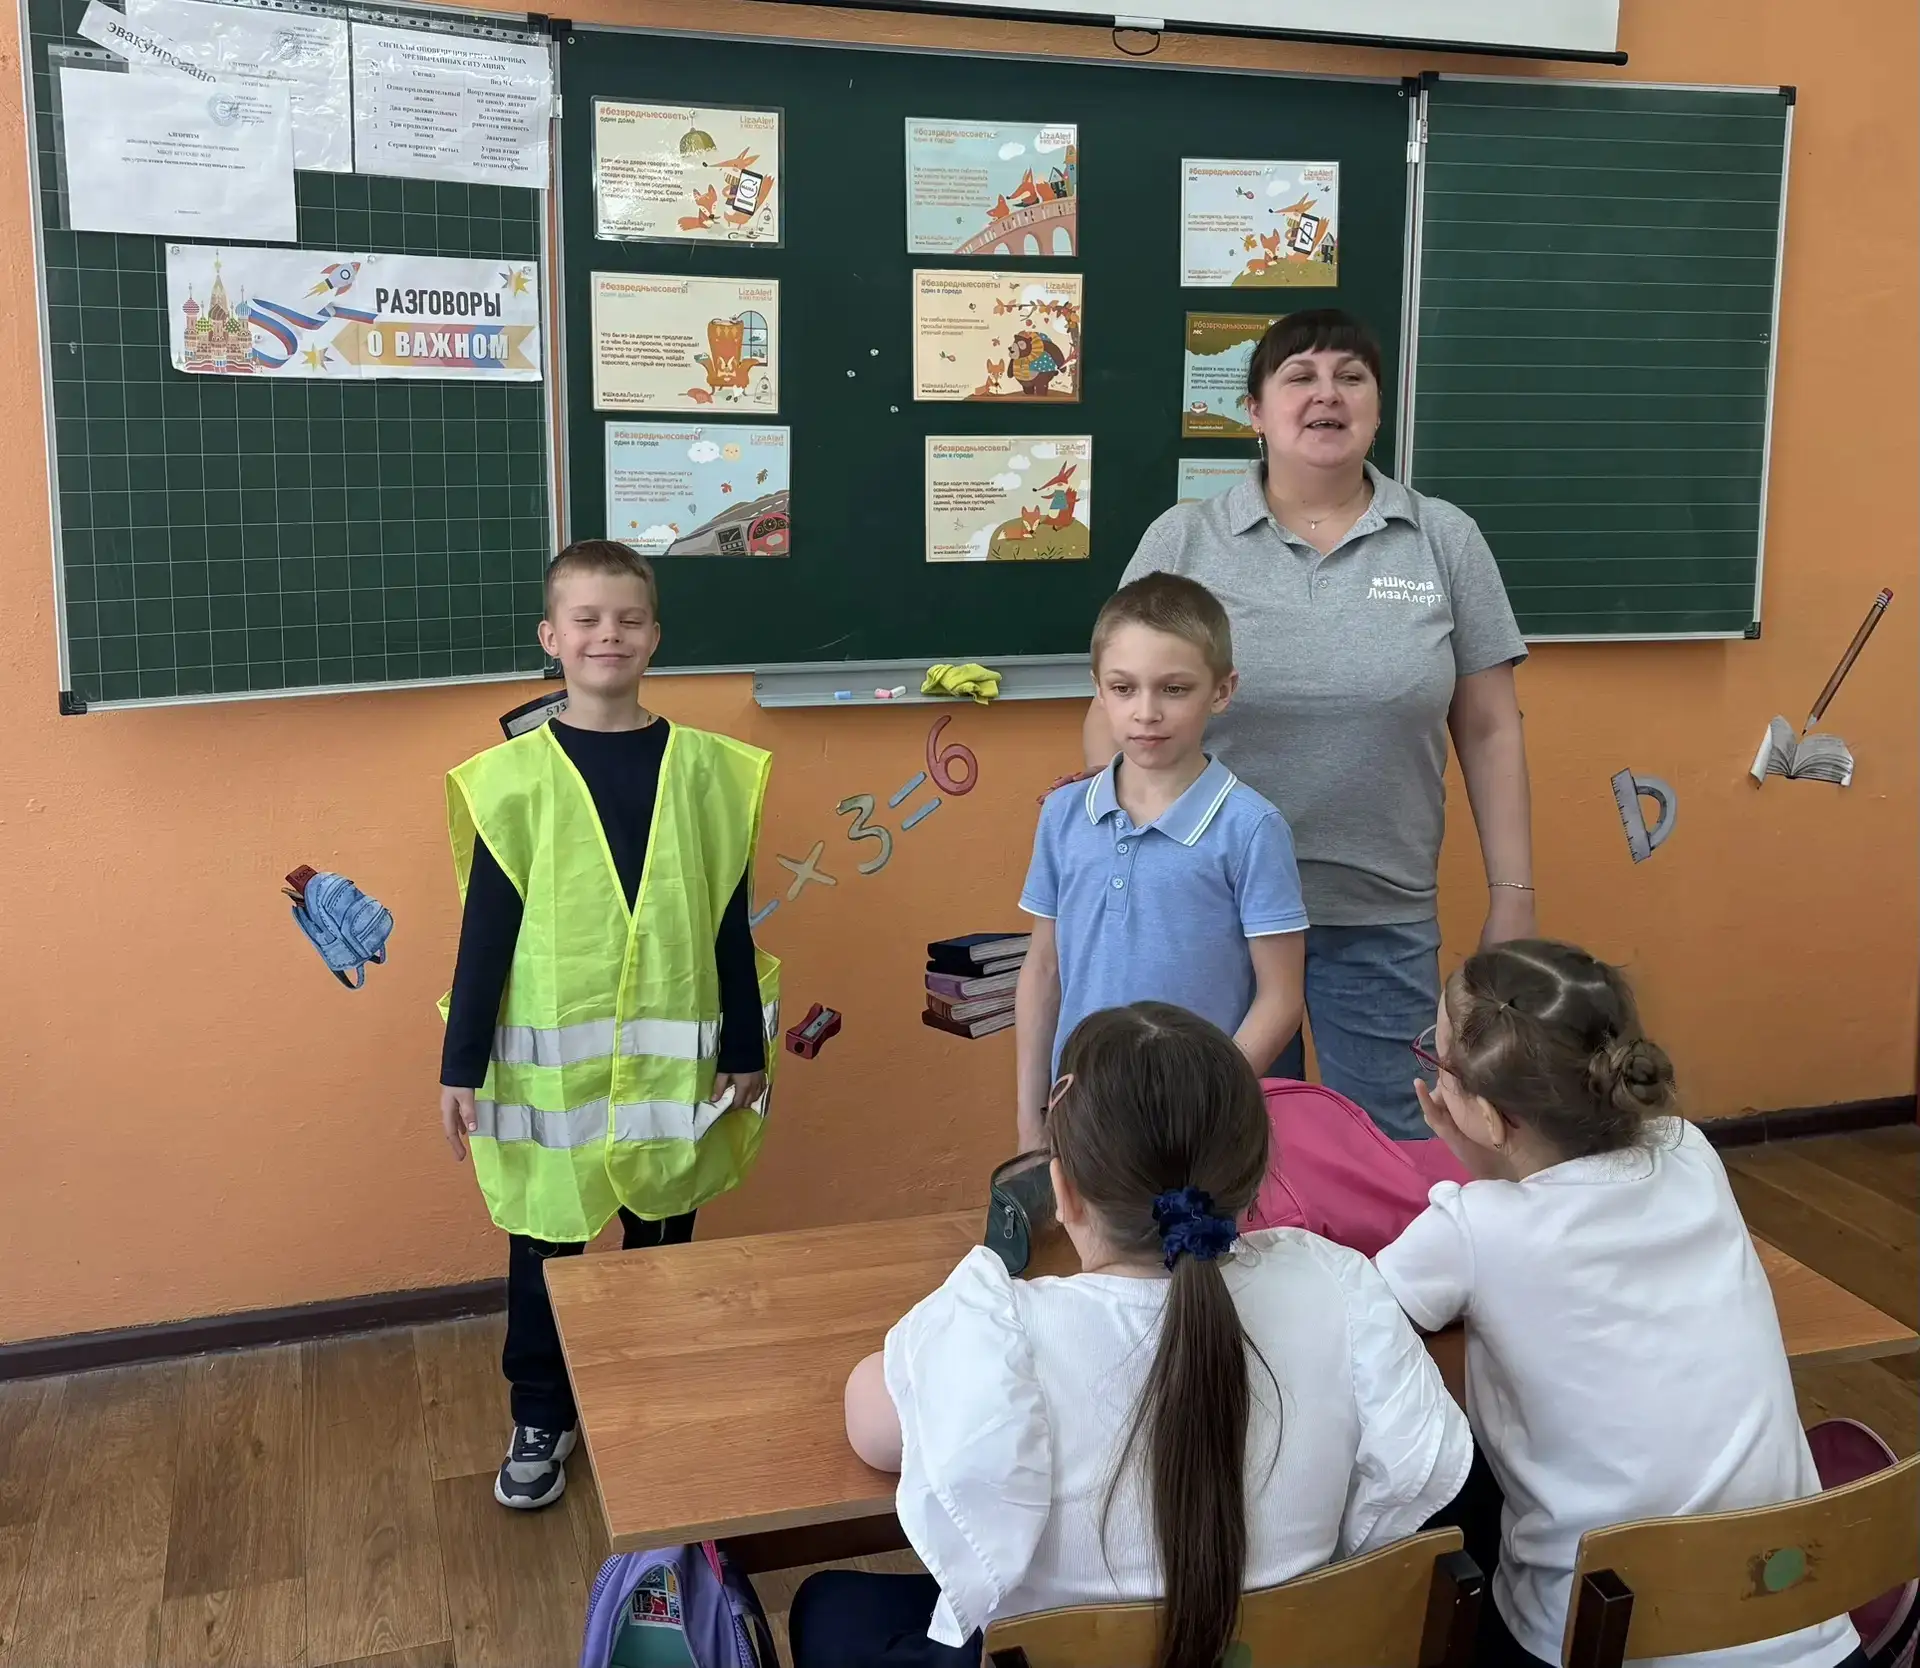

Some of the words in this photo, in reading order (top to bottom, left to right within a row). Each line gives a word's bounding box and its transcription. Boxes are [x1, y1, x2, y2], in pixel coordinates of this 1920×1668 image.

[378, 41, 415, 50] СИГНАЛЫ
[401, 53, 462, 66] ЧРЕЗВЫЧАЙНЫХ
[462, 60, 506, 70] СИТУАЦИЯХ
[921, 279, 1000, 288] #безвредныесоветы
[376, 288, 500, 317] РАЗГОВОРЫ
[367, 330, 383, 357] О
[395, 332, 509, 360] ВАЖНОМ
[1372, 576, 1434, 592] #Школа
[1366, 588, 1443, 607] ЛизаАлерт
[836, 794, 893, 875] 3
[926, 715, 978, 796] 6
